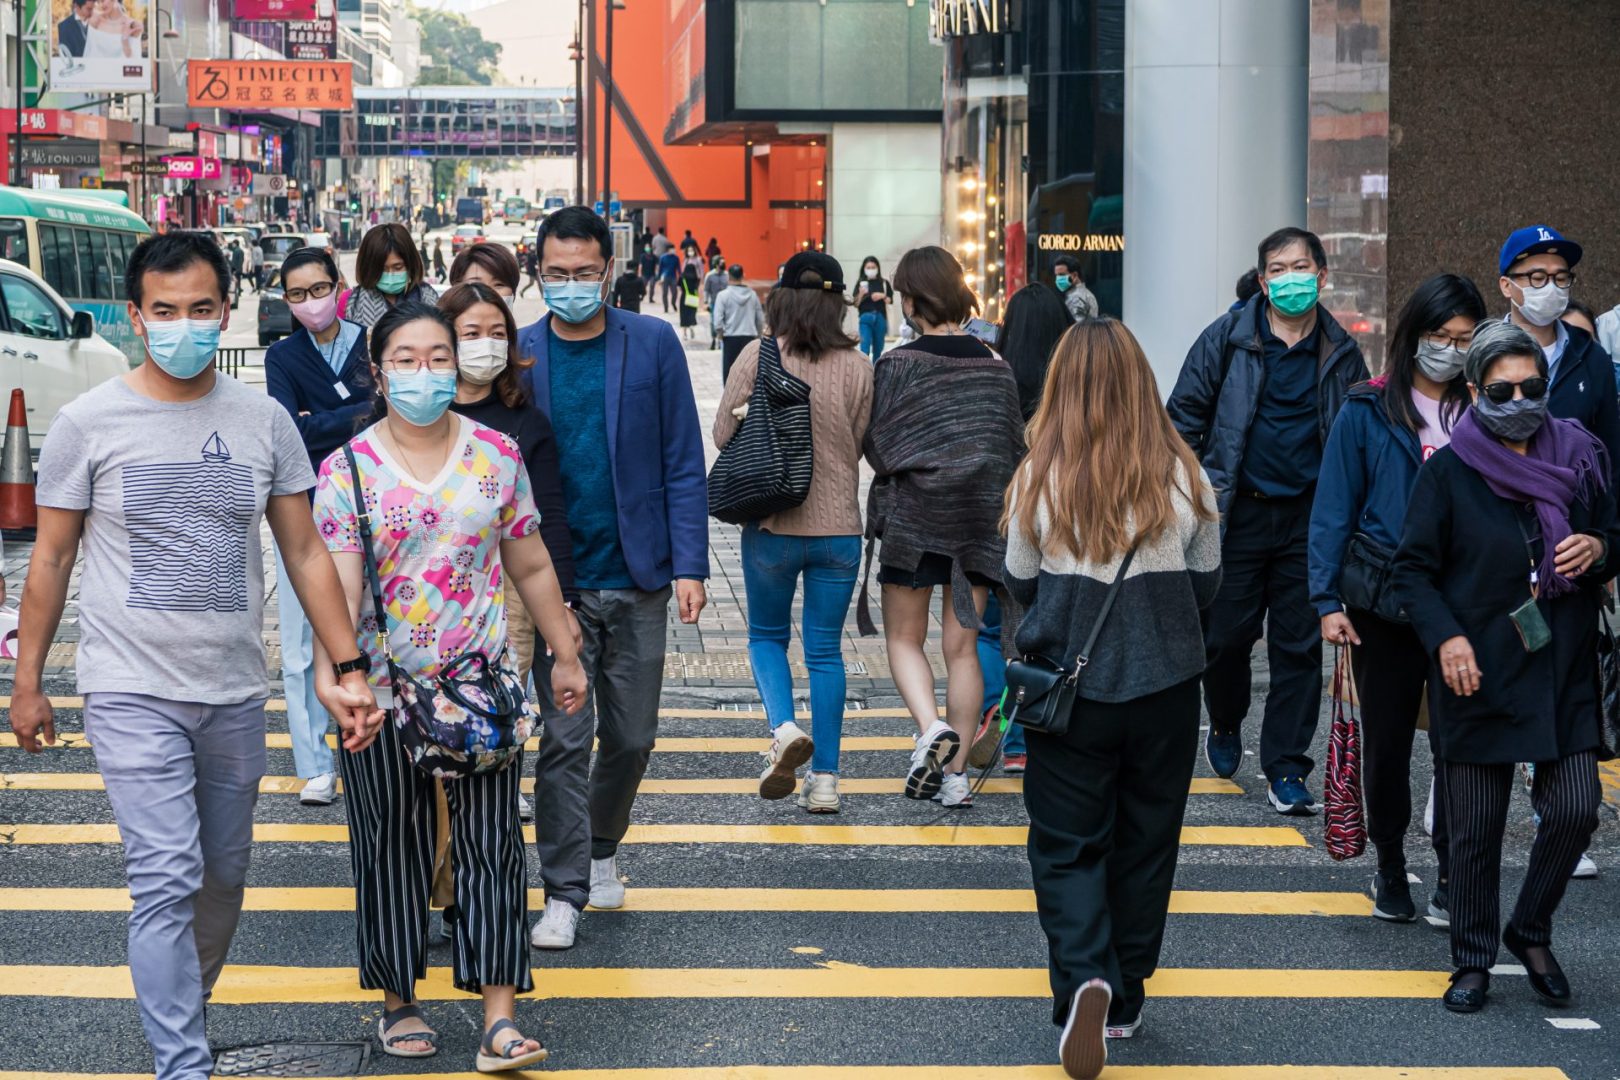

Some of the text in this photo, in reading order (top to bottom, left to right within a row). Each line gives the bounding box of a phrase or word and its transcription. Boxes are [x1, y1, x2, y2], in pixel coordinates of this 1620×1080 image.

[288, 20, 332, 31] SUPER PICO
[234, 66, 344, 82] TIMECITY
[236, 86, 344, 102] 冠亞名表城
[1038, 234, 1081, 251] GIORGIO
